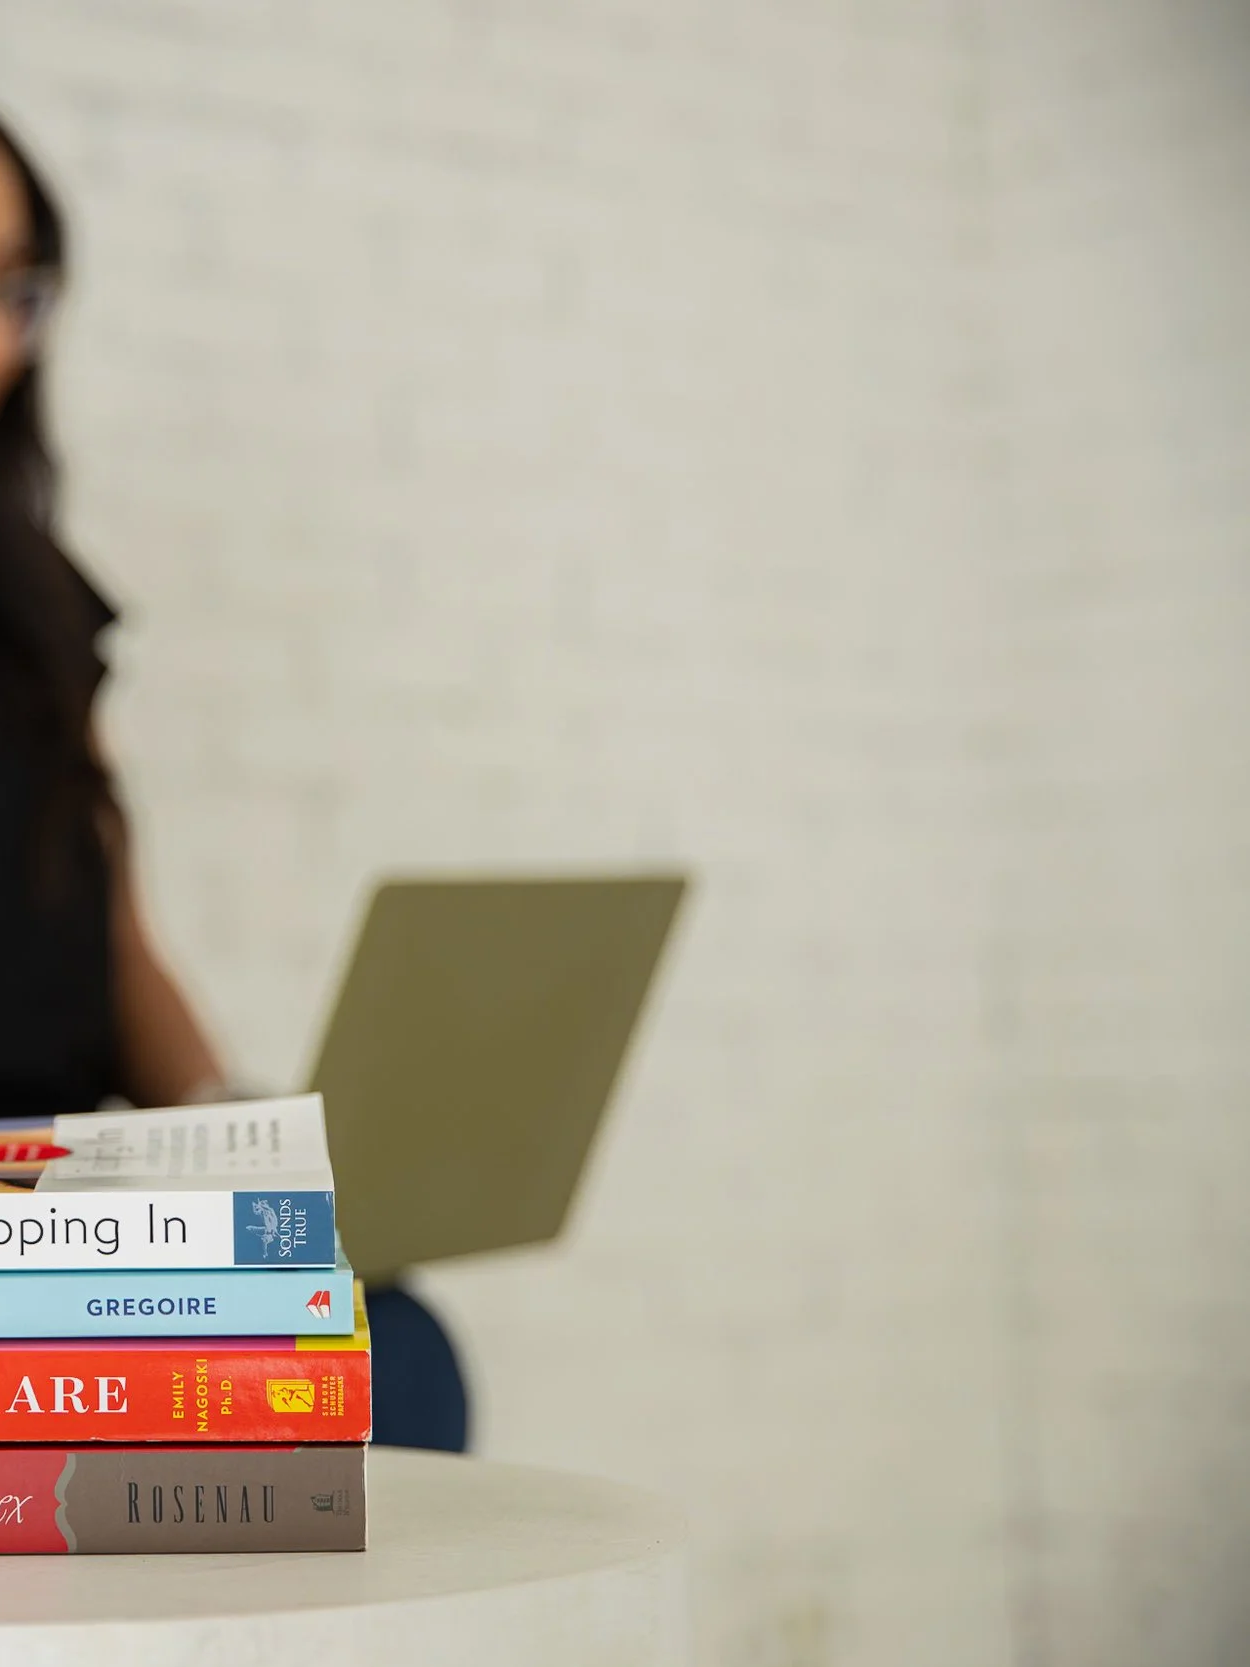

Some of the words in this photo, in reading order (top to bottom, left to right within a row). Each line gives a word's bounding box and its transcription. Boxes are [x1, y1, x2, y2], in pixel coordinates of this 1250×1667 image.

[148, 1203, 188, 1244] In
[278, 1198, 292, 1258] SOUNDS
[293, 1208, 308, 1248] TRUE
[86, 1297, 217, 1316] GREGOIRE
[4, 1375, 130, 1414] ARE
[172, 1371, 185, 1420] EMILY
[196, 1358, 209, 1433] NAGOSKI
[220, 1374, 233, 1416] Ph.D.
[321, 1383, 329, 1417] SIMON
[329, 1375, 337, 1417] SCHUSTER
[127, 1481, 278, 1524] ROSENAU
